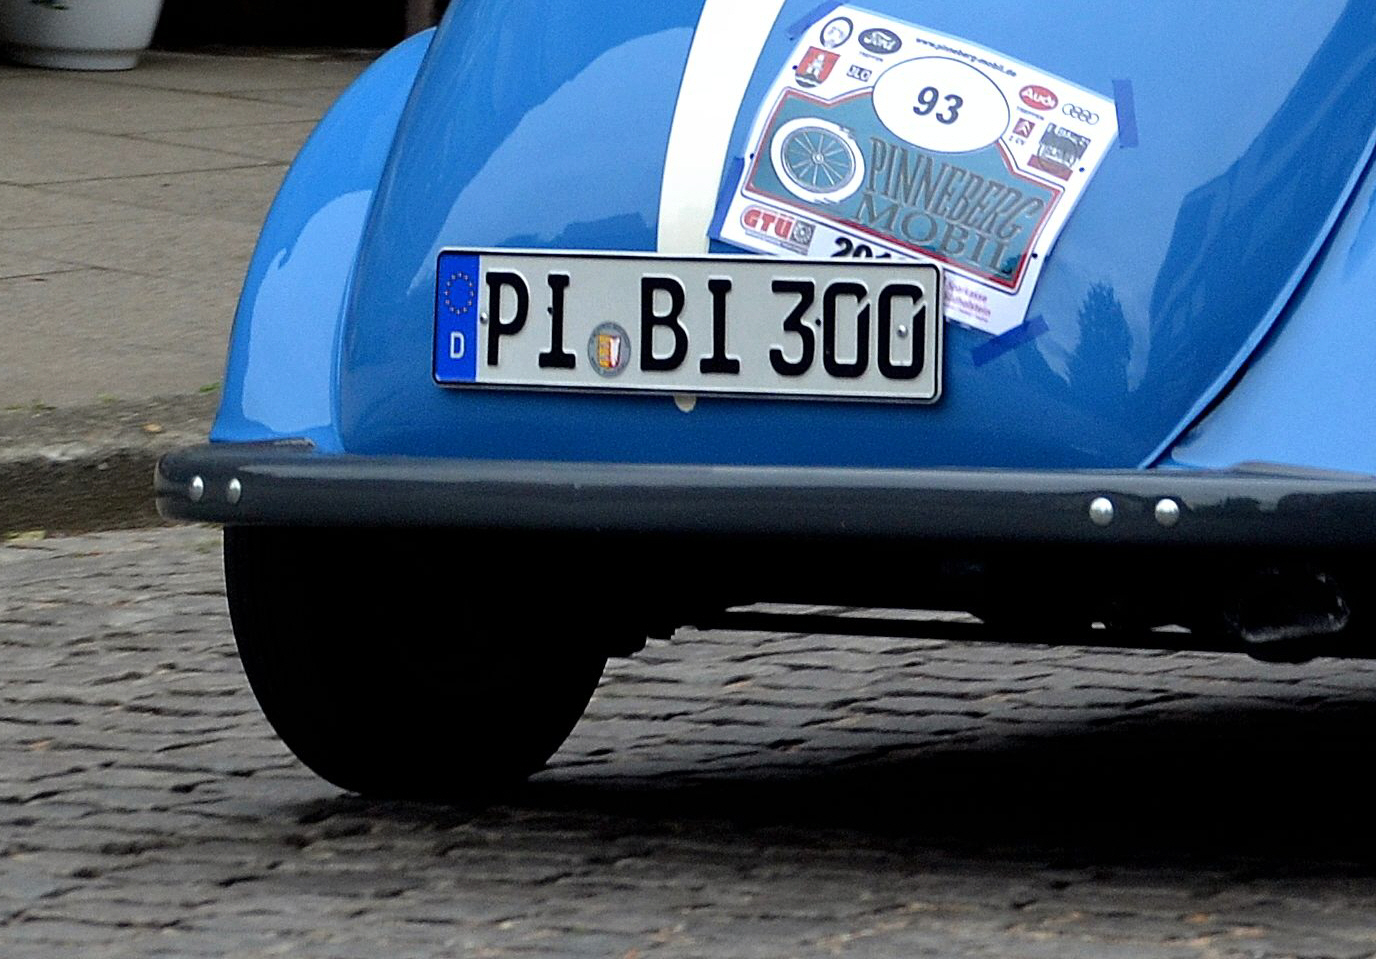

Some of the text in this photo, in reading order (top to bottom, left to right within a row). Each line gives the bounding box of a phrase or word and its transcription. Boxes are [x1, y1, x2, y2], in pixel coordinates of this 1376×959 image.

[863, 30, 897, 51] Ford
[912, 86, 964, 125] 93
[1020, 87, 1057, 109] Audi
[868, 136, 1046, 240] PINNEBERG
[854, 190, 1012, 274] MOBIL
[448, 331, 465, 359] D
[484, 271, 577, 369] PI
[639, 276, 741, 375] BI
[768, 279, 927, 380] 300
